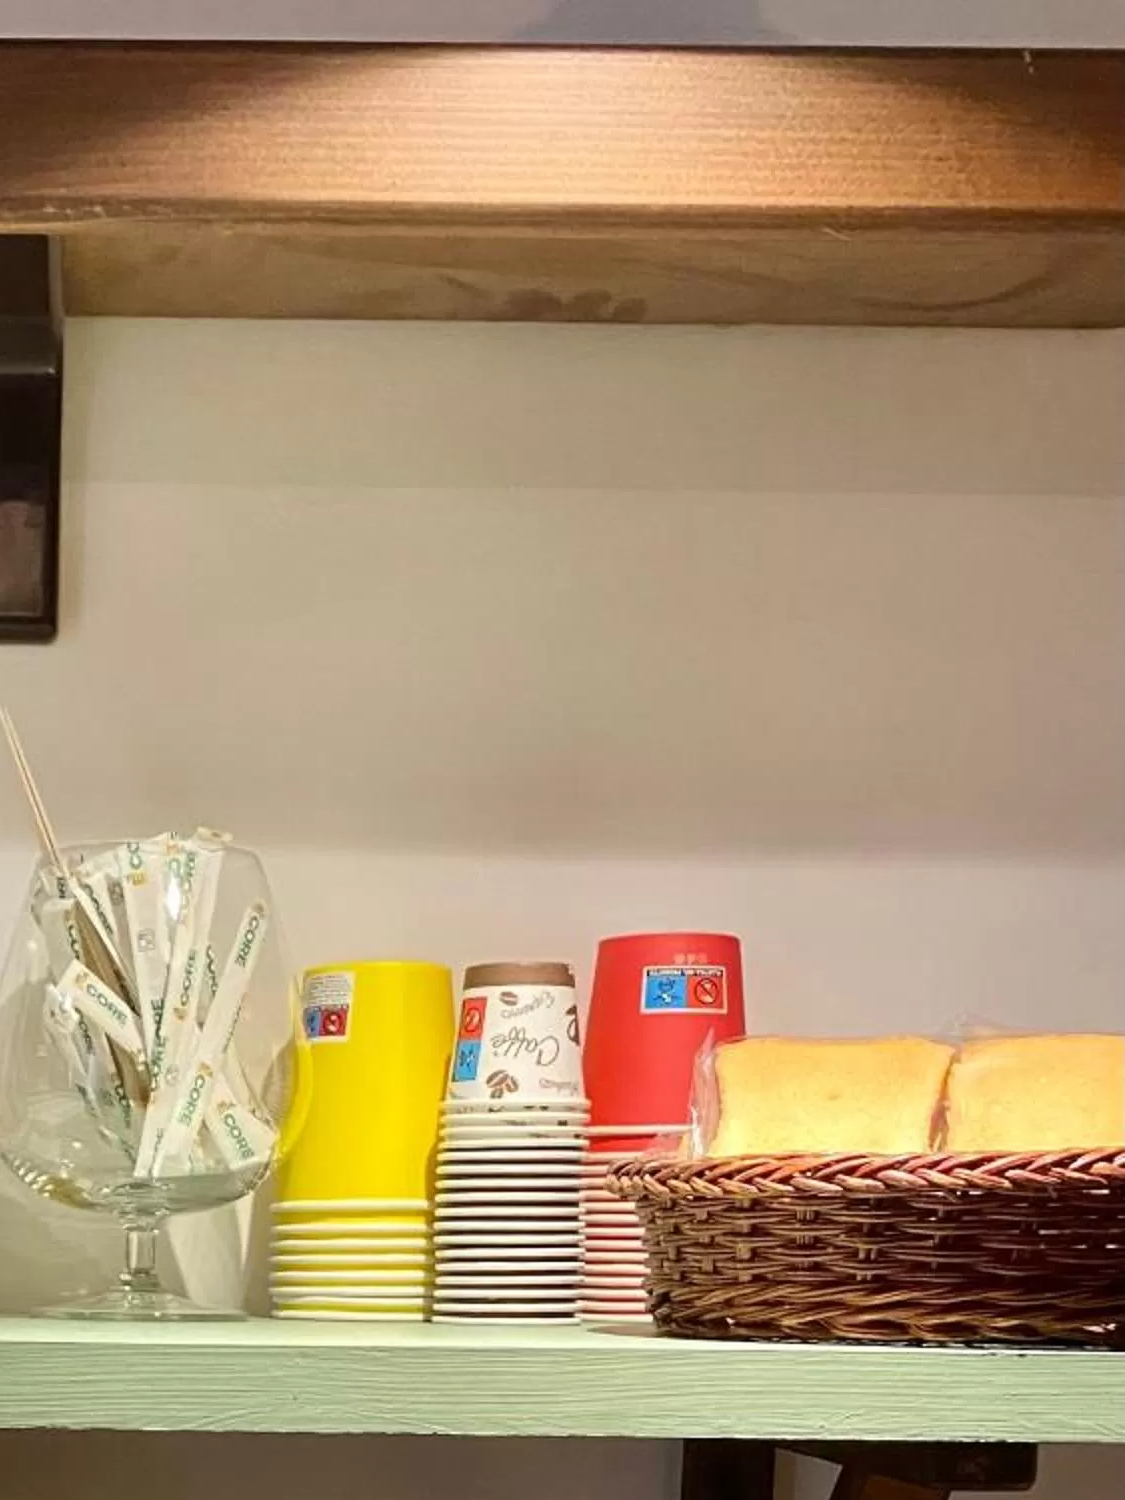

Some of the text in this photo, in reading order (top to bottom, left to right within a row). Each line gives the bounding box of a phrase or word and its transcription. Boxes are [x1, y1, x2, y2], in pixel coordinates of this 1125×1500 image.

[235, 914, 260, 968] CORE
[179, 949, 197, 1006] CORE
[86, 983, 129, 1030] CORE
[179, 1074, 206, 1127] CORE
[224, 1112, 257, 1159] CORE
